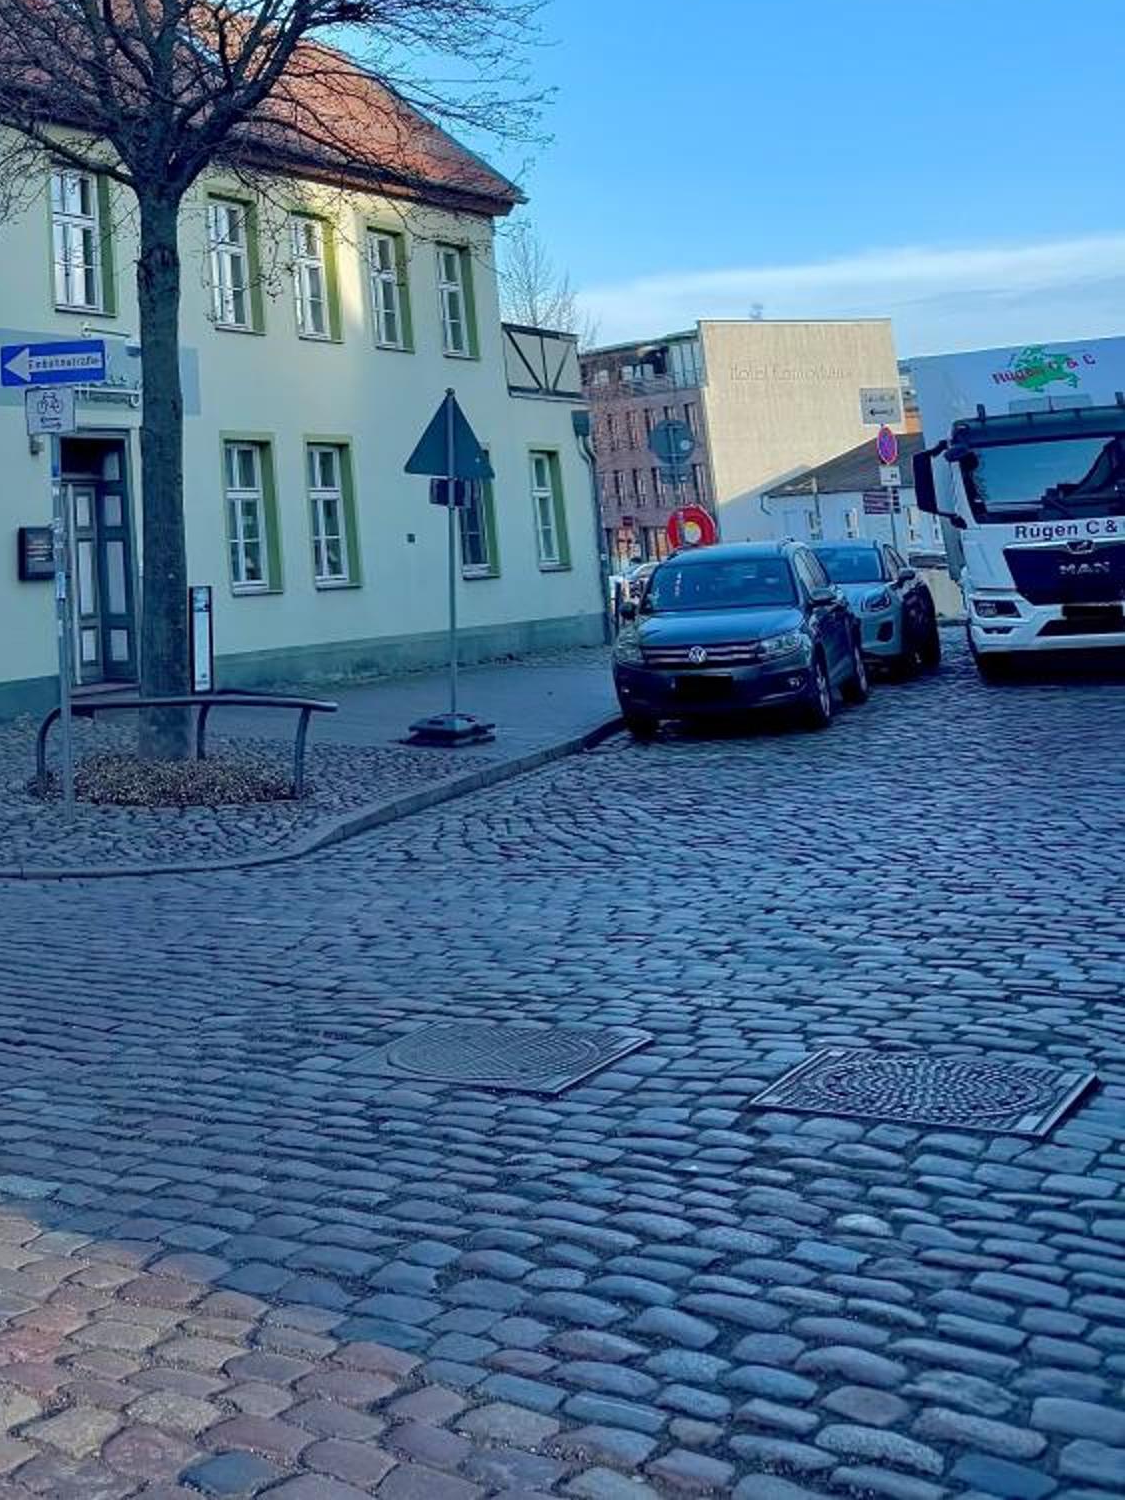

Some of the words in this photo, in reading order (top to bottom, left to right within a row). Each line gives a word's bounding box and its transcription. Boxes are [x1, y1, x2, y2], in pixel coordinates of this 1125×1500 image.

[1086, 520, 1100, 534] C
[1105, 519, 1118, 533] &
[1059, 561, 1110, 575] MAN
